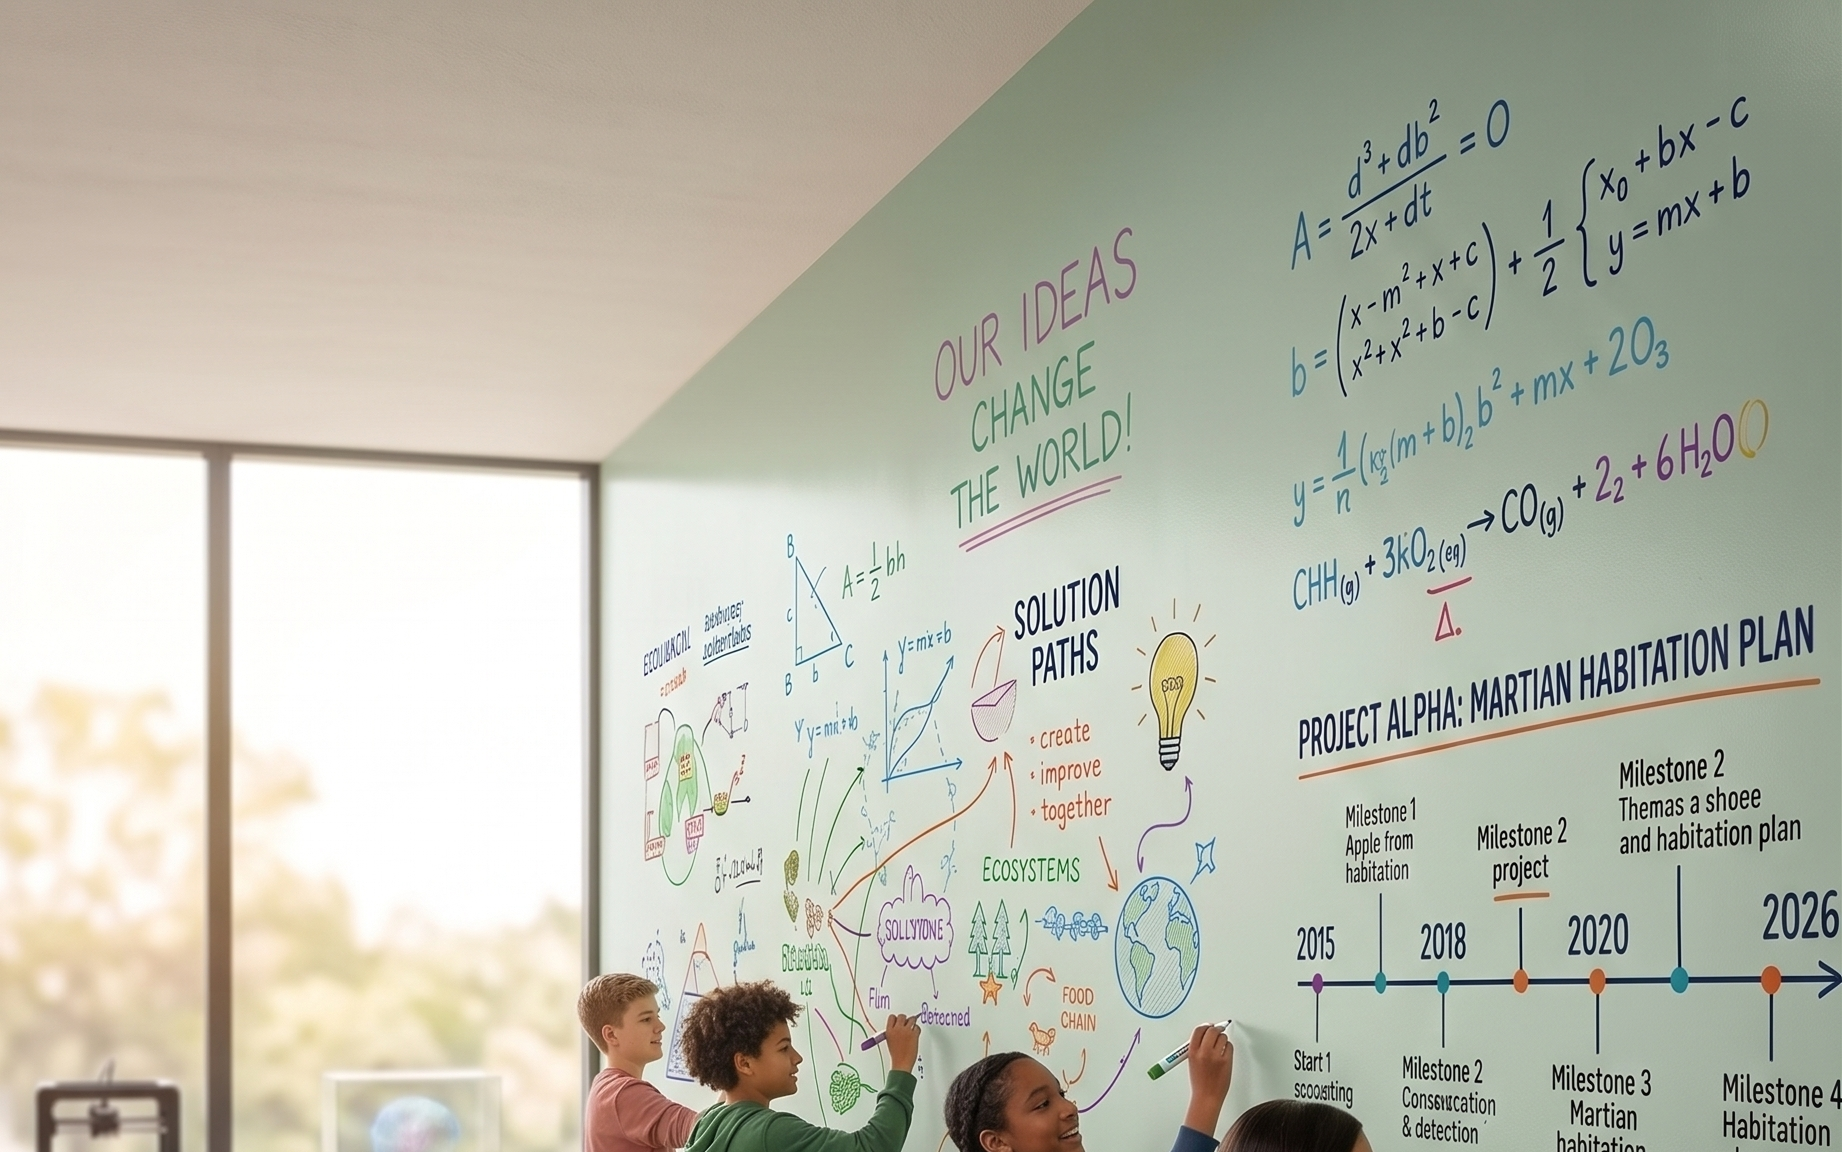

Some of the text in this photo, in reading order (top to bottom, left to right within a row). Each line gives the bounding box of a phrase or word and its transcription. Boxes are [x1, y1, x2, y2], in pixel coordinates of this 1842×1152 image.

[934, 226, 1138, 402] OUR IDEAS
[970, 340, 1096, 453] CHANGE
[950, 391, 1132, 529] THE WORLD!
[1014, 564, 1121, 641] SOLUTION
[1031, 628, 1100, 688] PATHS
[1298, 603, 1815, 760] PROJECT ALPHA: MARTIAN HABITATION PLAN
[1040, 718, 1092, 750] create
[1040, 758, 1102, 794] improve
[1618, 747, 1726, 790] Milestone 2
[1041, 793, 1112, 832] together
[1344, 803, 1408, 830] Milestone
[1618, 785, 1763, 823] Themas a shoee
[1345, 828, 1414, 861] Apple from
[1476, 816, 1568, 852] Milestone 2
[1618, 814, 1802, 856] and habitation plan
[982, 855, 1081, 884] ECOSYSTEMS
[1345, 858, 1410, 885] habitation
[1492, 852, 1550, 890] project
[1296, 888, 1840, 962] 2015 2018 2020 2026
[1062, 985, 1095, 1008] FOOD
[1060, 1010, 1097, 1034] CHAIN
[1293, 1048, 1324, 1073] Start
[1401, 1054, 1484, 1084] Milestone 2
[1551, 1063, 1653, 1099] Milestone 3
[1722, 1072, 1842, 1110] Milestone 4
[1401, 1114, 1479, 1145] & detection
[1569, 1098, 1638, 1132] Martian
[1722, 1109, 1831, 1147] Habitation
